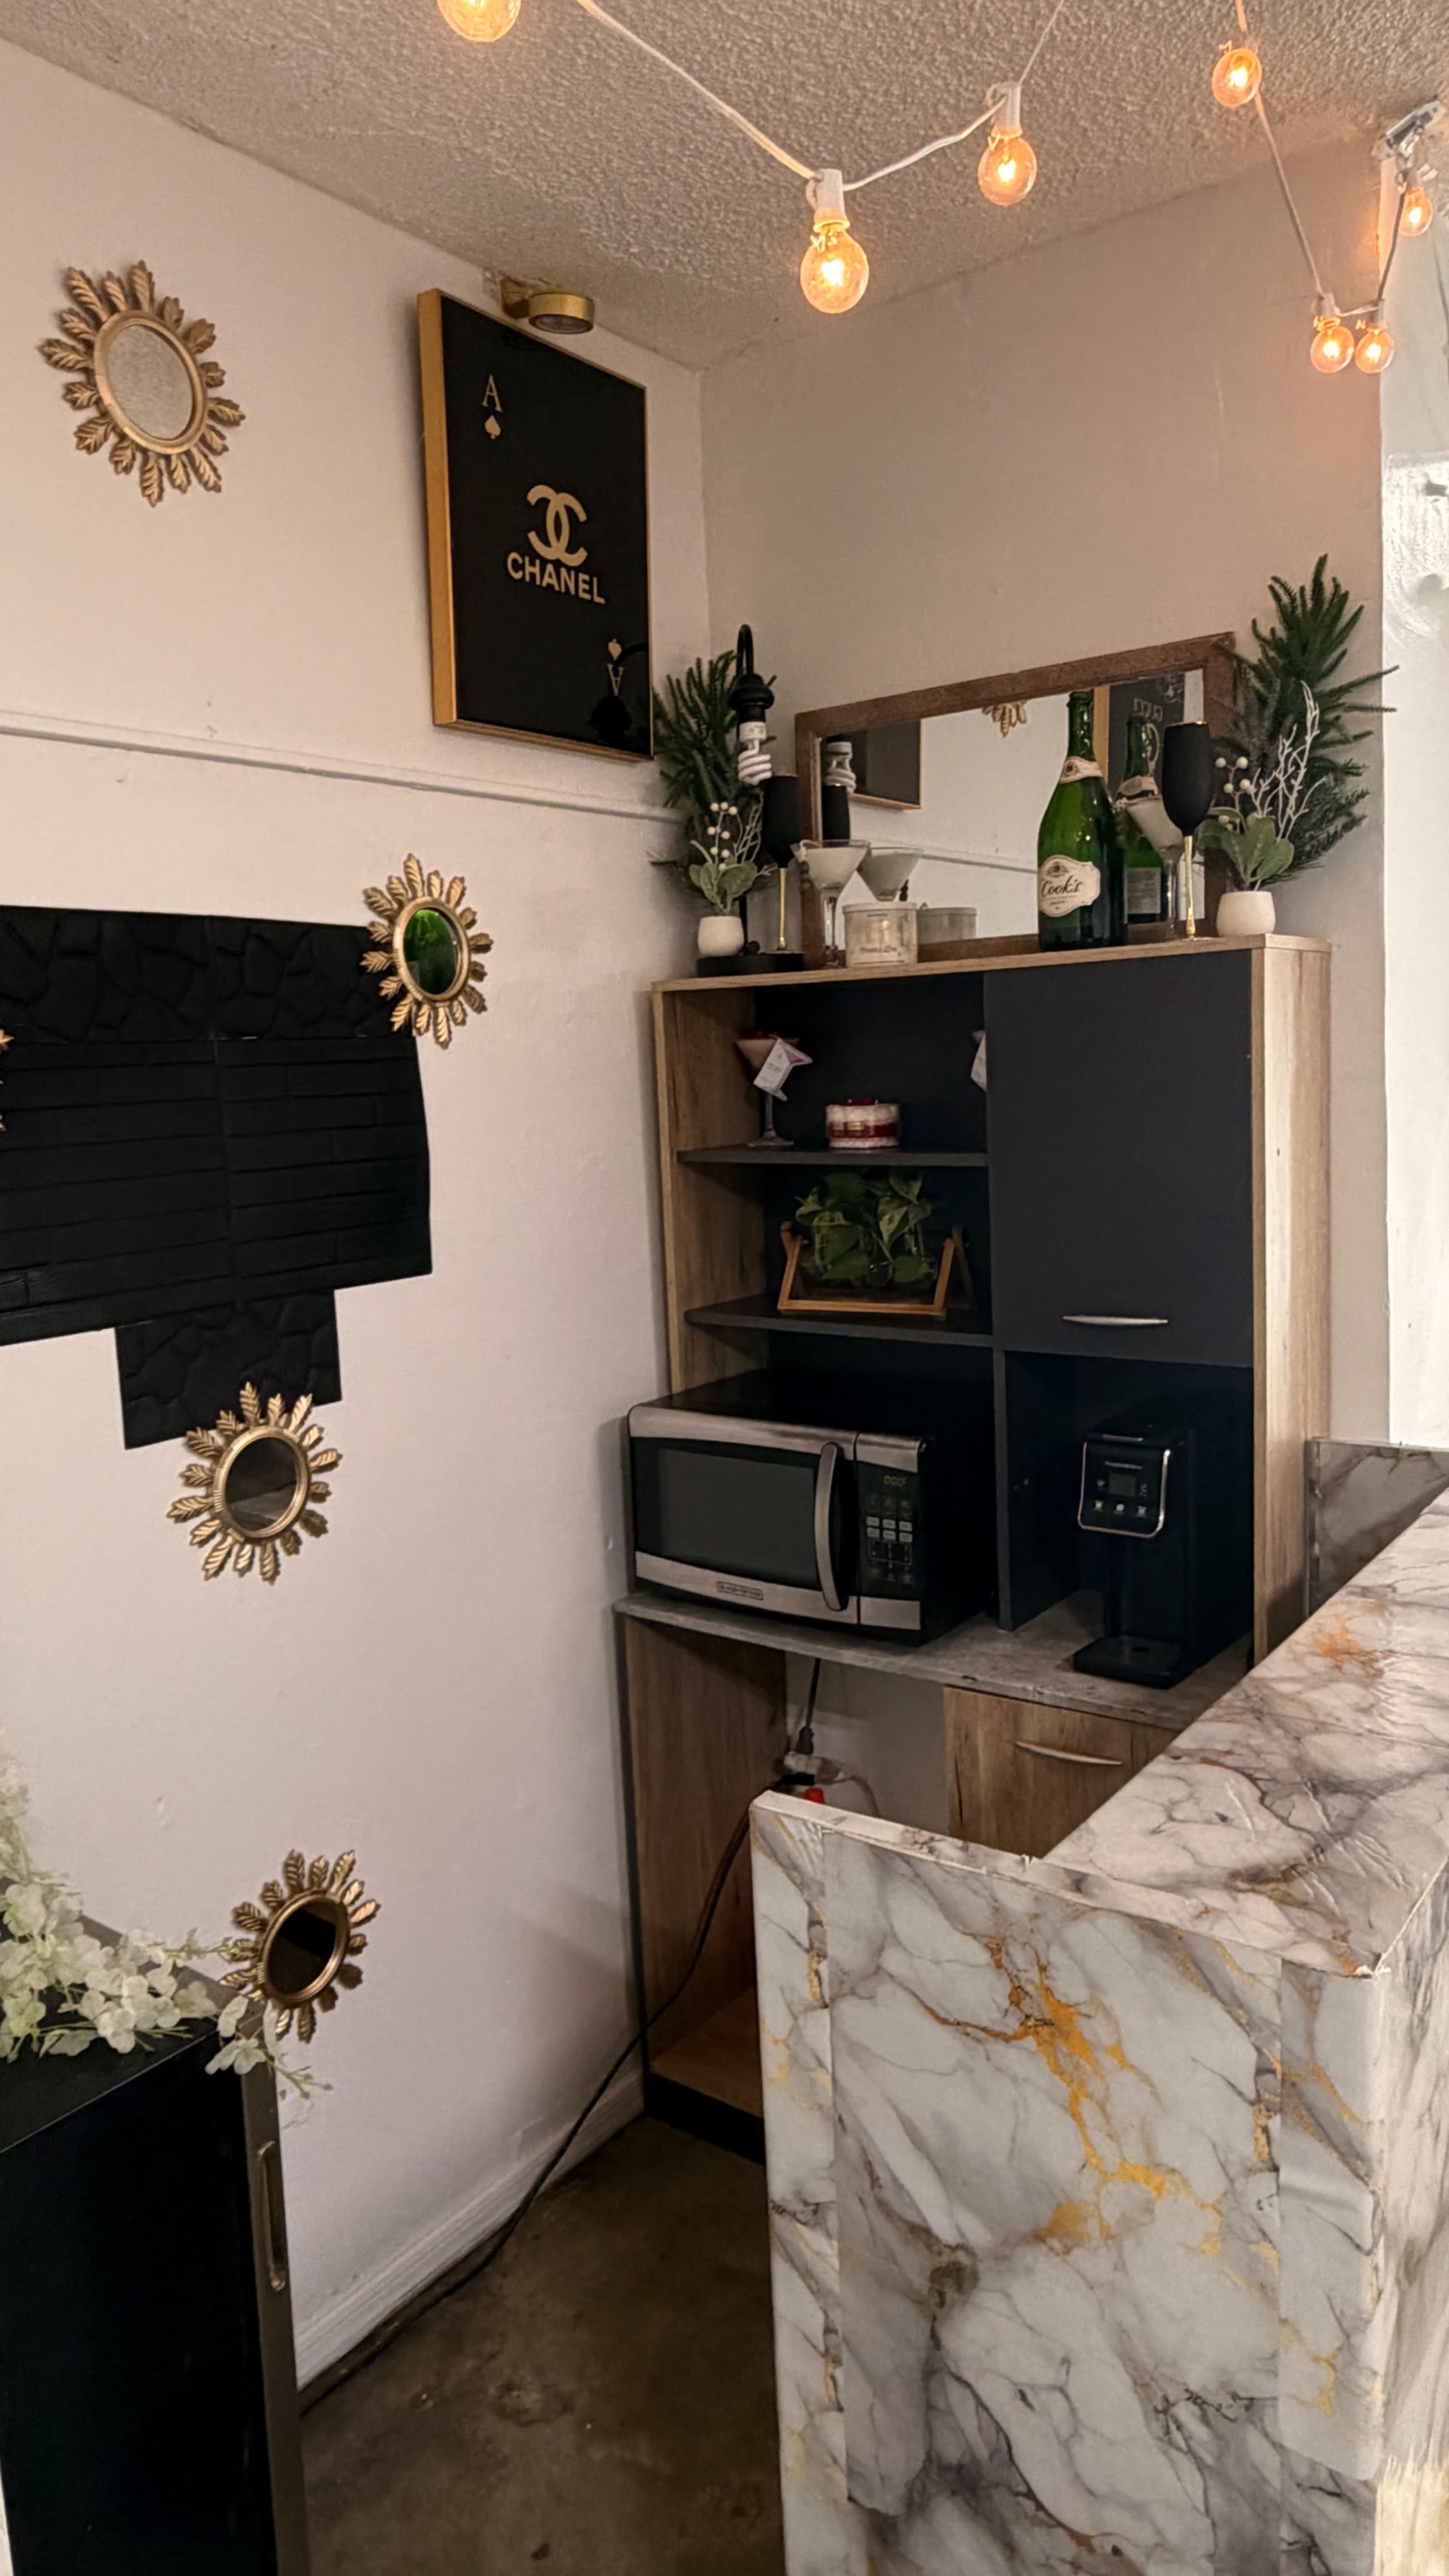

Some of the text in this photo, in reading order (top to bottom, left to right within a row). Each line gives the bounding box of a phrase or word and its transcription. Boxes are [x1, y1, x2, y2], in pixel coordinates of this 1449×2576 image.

[481, 374, 503, 413] A
[507, 551, 606, 605] CHANEL
[607, 663, 624, 696] A
[1041, 875, 1084, 898] Cook's
